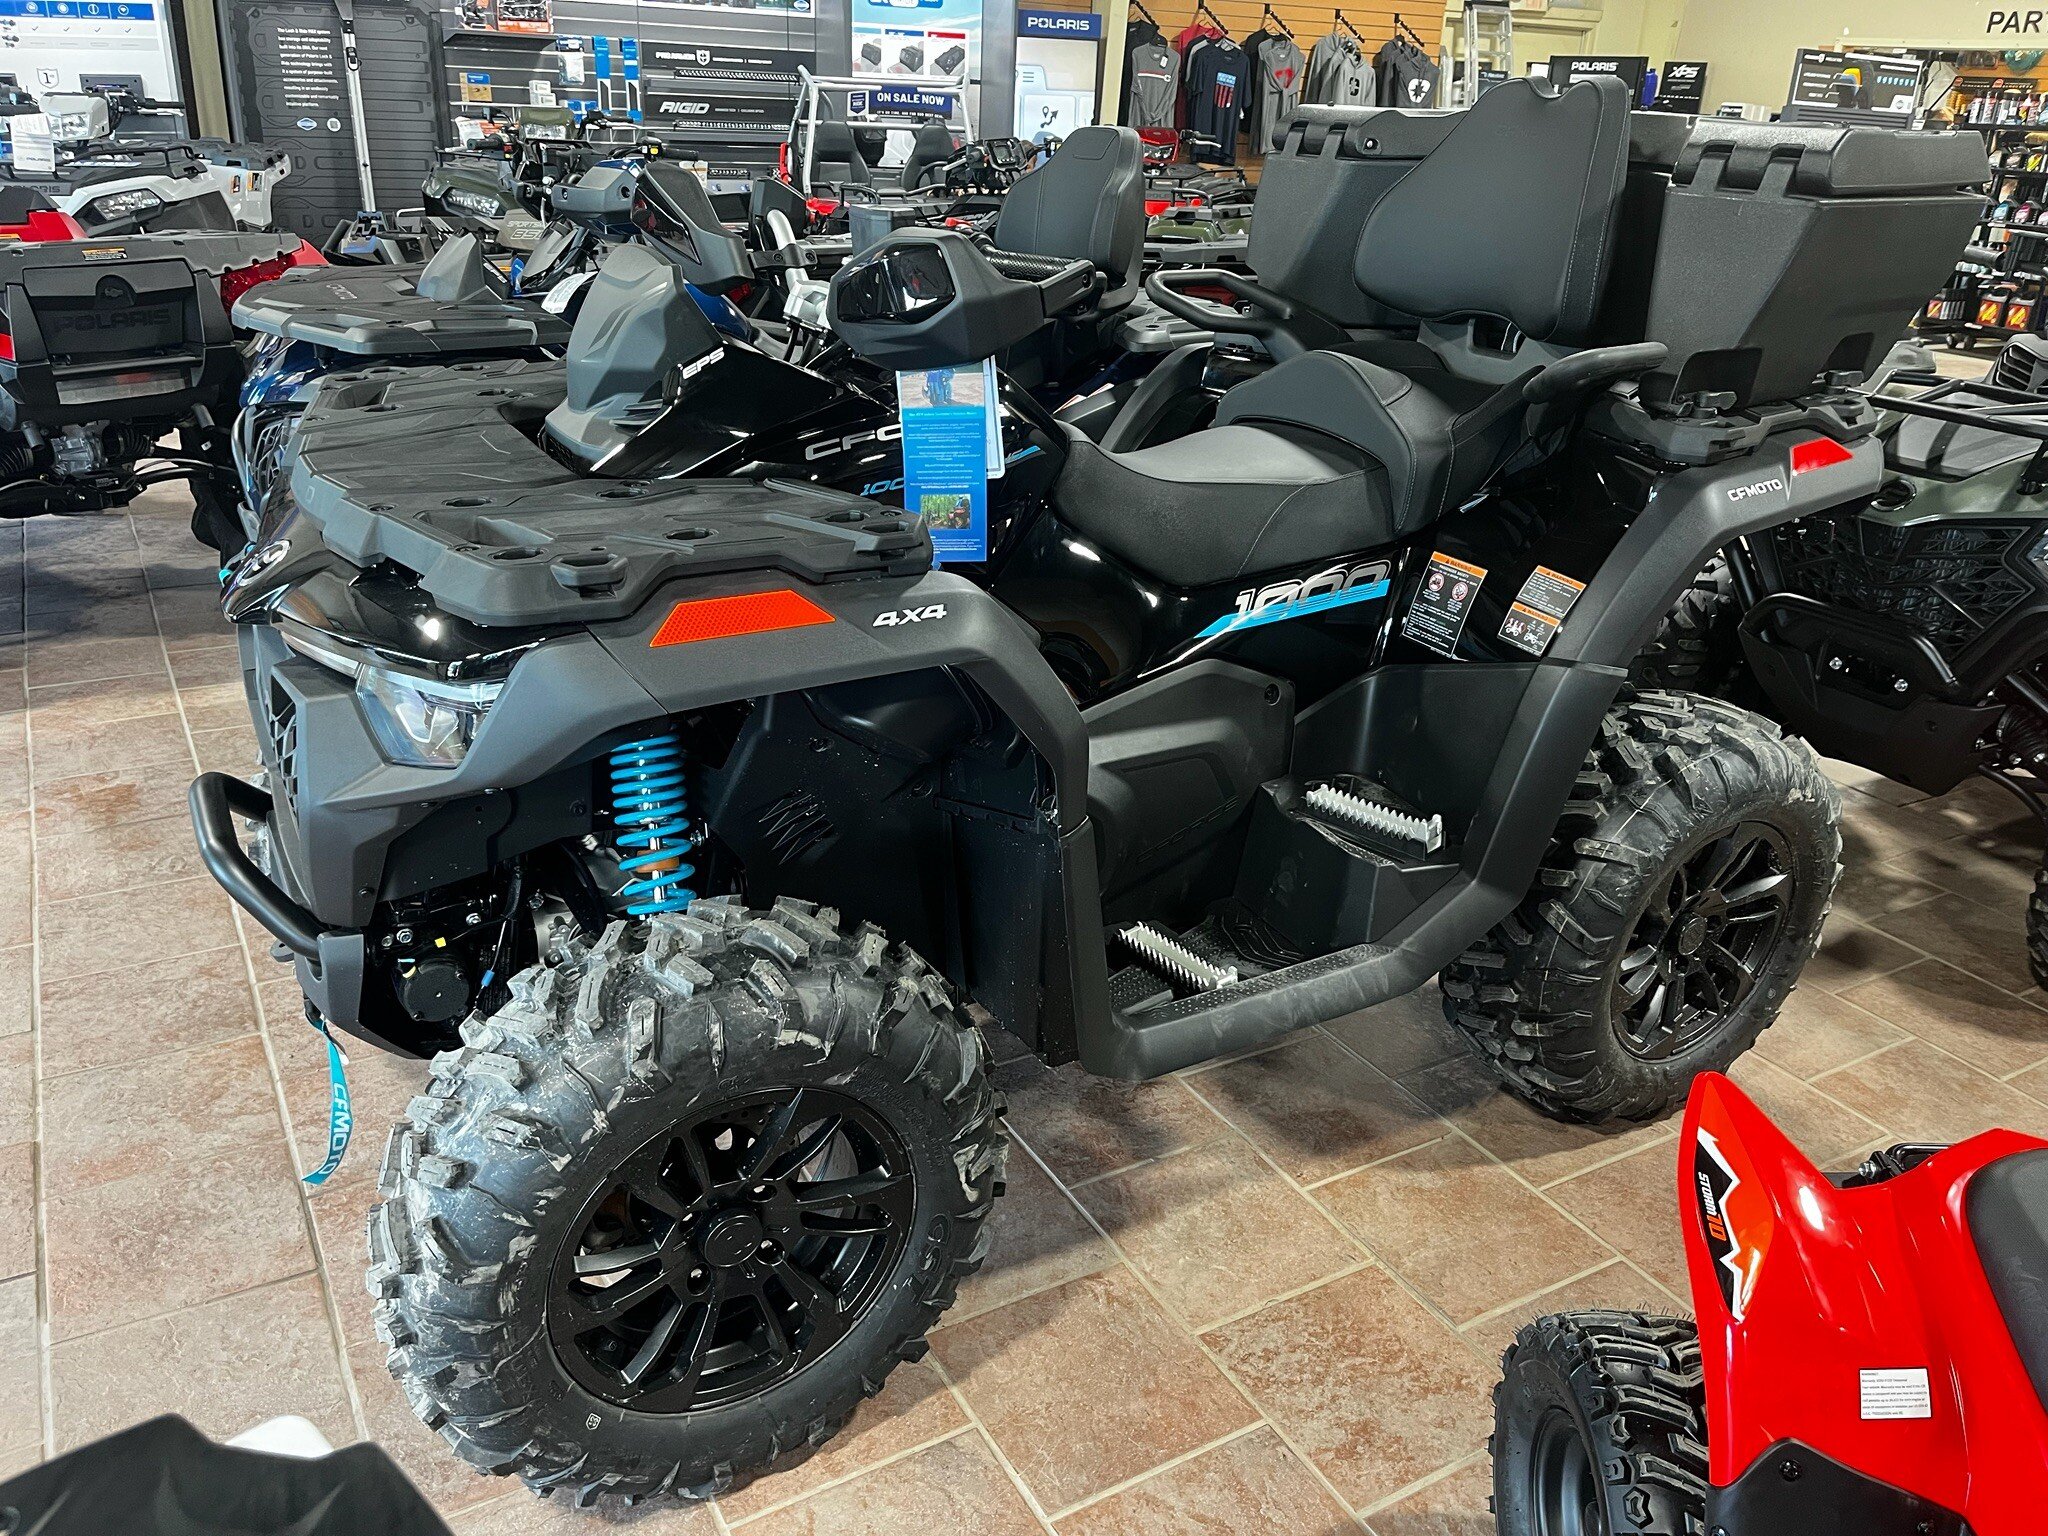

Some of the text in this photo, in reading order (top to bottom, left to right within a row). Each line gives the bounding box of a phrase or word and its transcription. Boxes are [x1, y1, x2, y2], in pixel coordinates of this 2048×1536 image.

[1027, 16, 1091, 31] POLARIS
[1986, 11, 2048, 33] PAR
[1571, 62, 1617, 72] POLARIS
[1668, 64, 1700, 78] XPS
[660, 102, 710, 114] RIGID
[877, 92, 945, 106] ON SALE NOW
[683, 347, 725, 380] EPS
[805, 423, 902, 461] CFO
[860, 477, 905, 497] 100
[1727, 478, 1783, 502] CFMOTO
[1234, 559, 1391, 622] 1000
[872, 604, 947, 627] 4X4
[318, 1082, 351, 1176] CFMOTO
